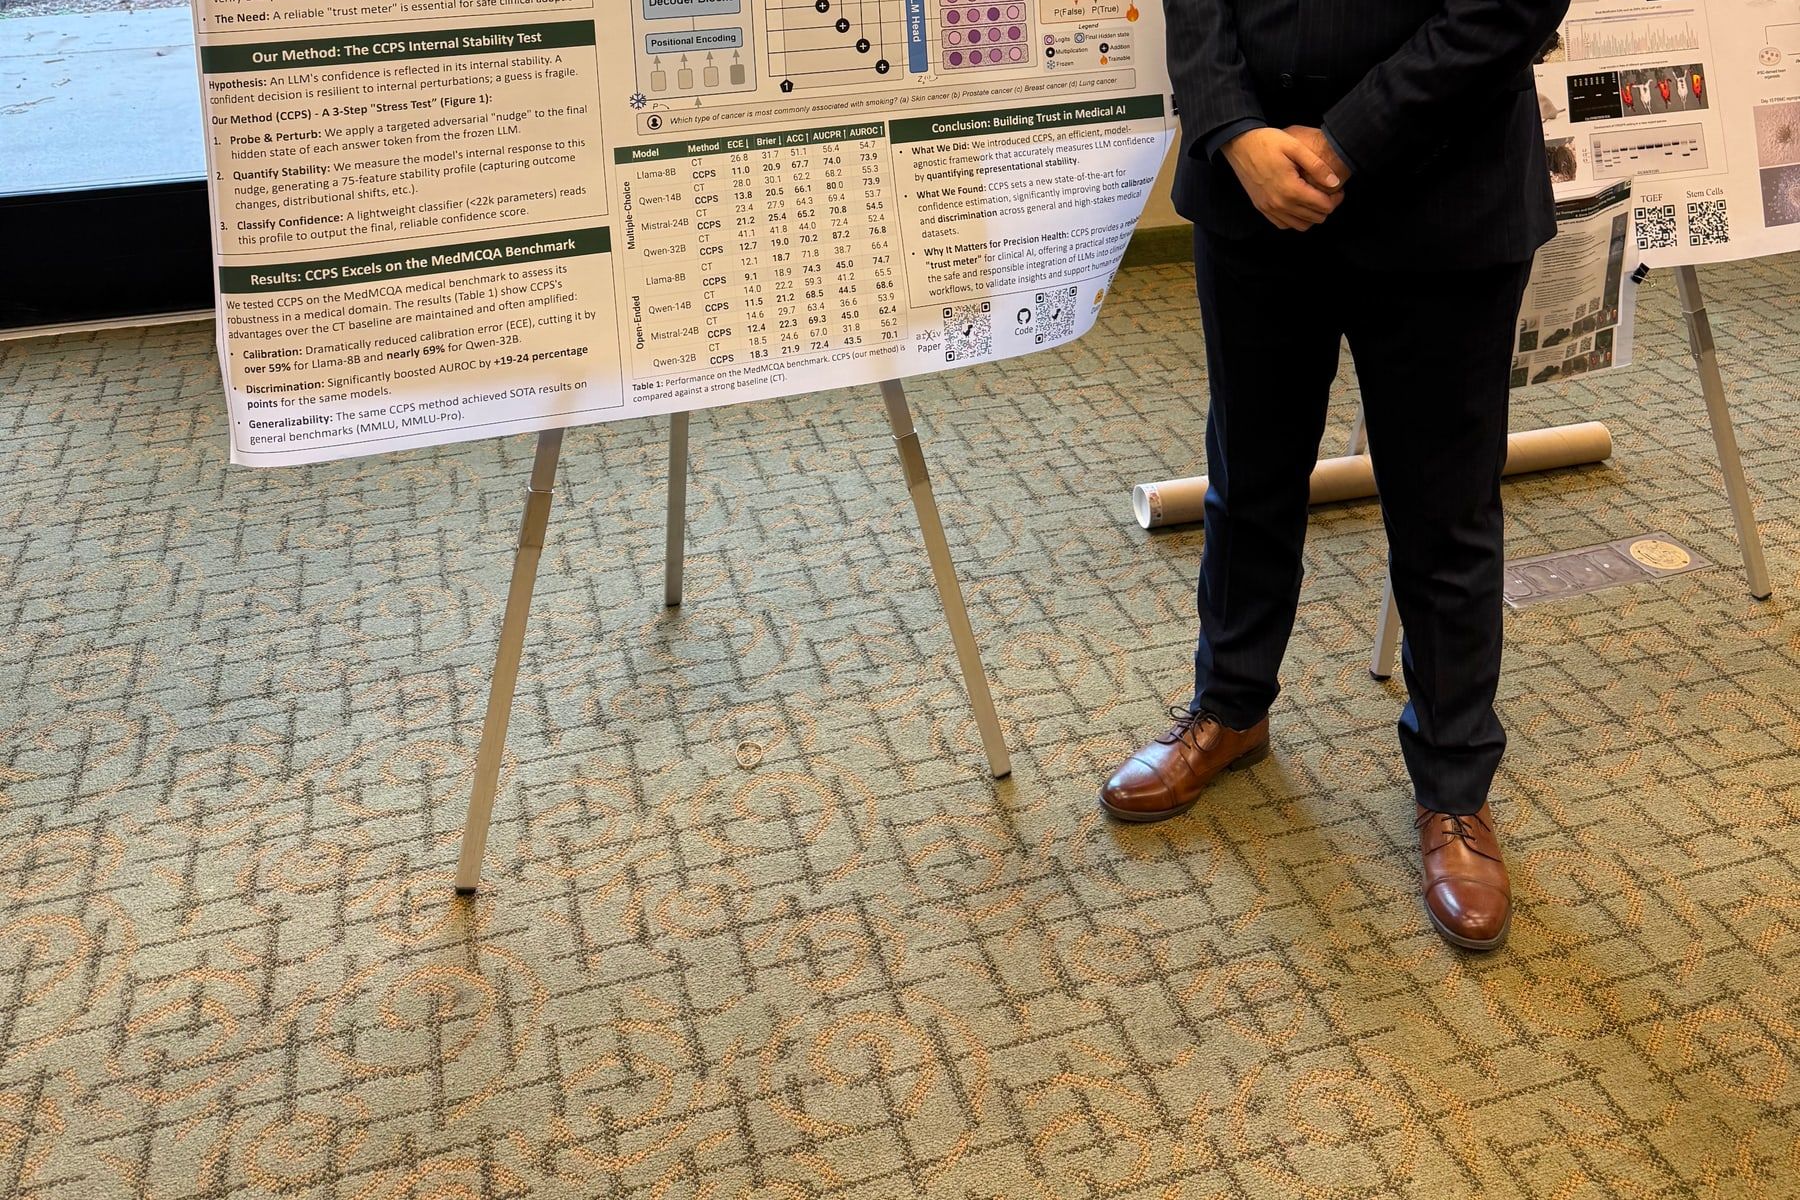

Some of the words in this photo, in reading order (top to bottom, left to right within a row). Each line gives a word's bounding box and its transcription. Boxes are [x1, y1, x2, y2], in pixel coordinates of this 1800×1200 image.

[1054, 7, 1085, 16] P(False)
[1092, 5, 1119, 13] P(True)
[912, 16, 921, 42] Head
[252, 51, 278, 62] Our
[281, 46, 340, 60] Method:
[343, 44, 368, 56] The
[372, 41, 405, 54] CCPS
[408, 37, 458, 51] Internal
[462, 34, 514, 47] Stability
[516, 32, 541, 43] Test
[650, 36, 693, 47] Positional
[695, 34, 736, 43] Encoding
[931, 119, 990, 132] Conclusion:
[993, 114, 1034, 126] Building
[1035, 111, 1061, 122] Trust
[1063, 110, 1072, 119] in
[1075, 105, 1113, 118] Medical
[1115, 105, 1125, 114] AI
[632, 148, 660, 160] Model
[688, 142, 720, 153] Method
[637, 167, 676, 179] Llama-8B
[692, 169, 716, 180] CCPS
[732, 165, 750, 175] 11.0
[762, 162, 781, 172] 20.9
[791, 159, 809, 169] 67.7
[823, 156, 841, 166] 74.0
[860, 153, 878, 162] 73.9
[914, 173, 924, 182] by
[926, 168, 974, 181] quantifying
[975, 159, 1043, 175] representational
[1044, 156, 1079, 167] stability.
[638, 192, 682, 205] Qwen-14B
[1686, 190, 1704, 198] Stem
[1705, 187, 1723, 196] Cells
[624, 180, 636, 250] Multiple-Choice
[641, 218, 689, 231] Mistral-24B
[643, 244, 686, 257] Qwen-32B
[250, 271, 301, 285] Results:
[304, 267, 338, 281] CCPS
[341, 262, 382, 277] Excels
[385, 261, 402, 271] on
[405, 257, 427, 269] the
[431, 247, 502, 266] MedMCQA
[505, 238, 575, 256] Benchmark
[632, 295, 644, 350] Open-Ended
[1014, 326, 1034, 336] Code
[918, 342, 941, 353] Paper
